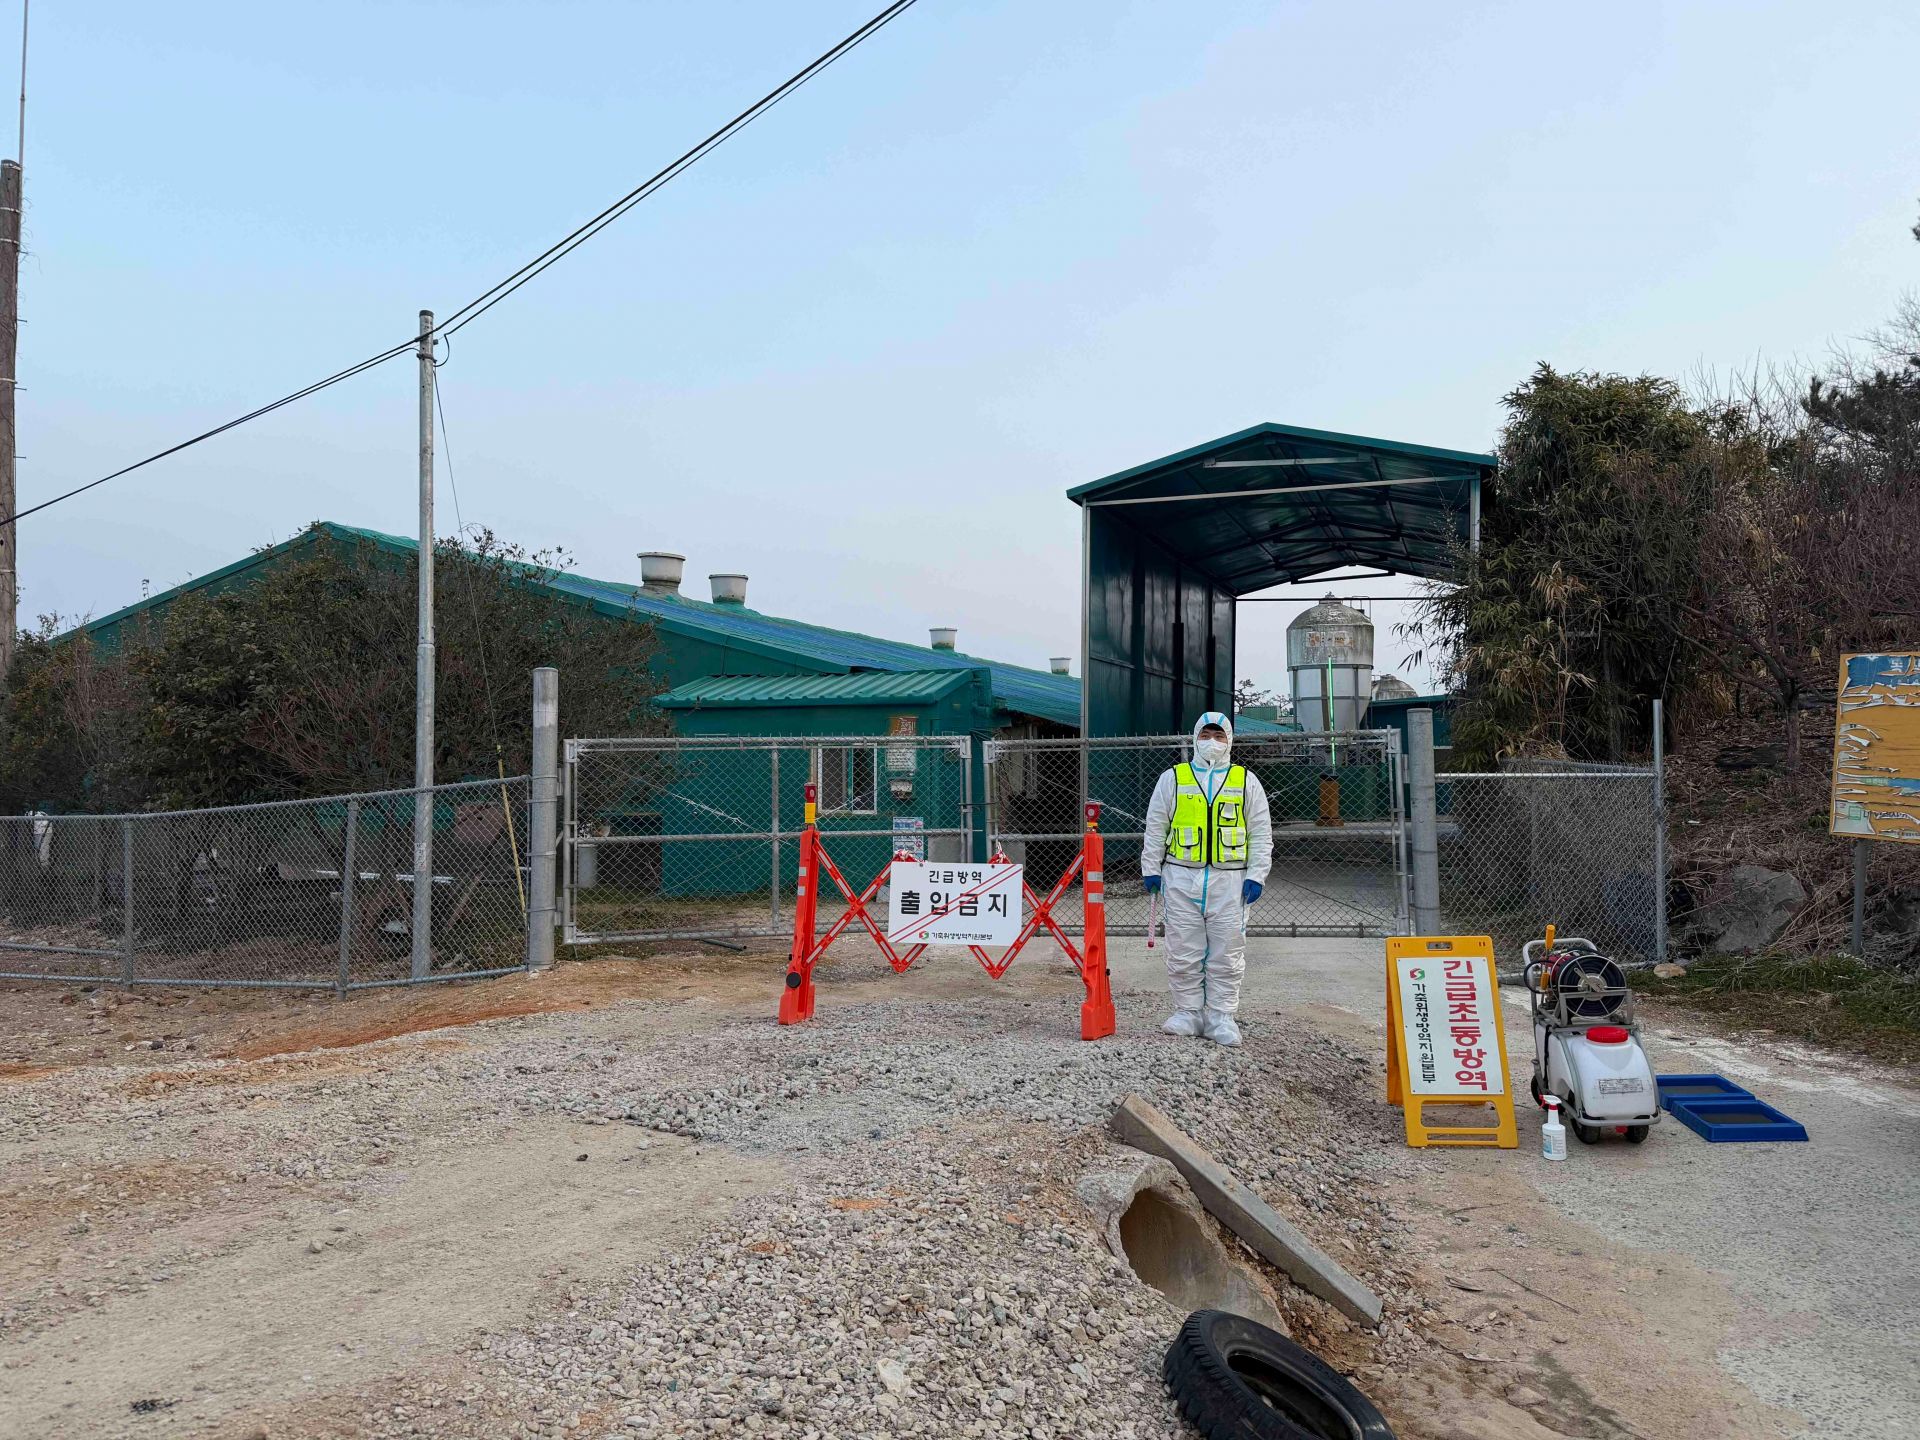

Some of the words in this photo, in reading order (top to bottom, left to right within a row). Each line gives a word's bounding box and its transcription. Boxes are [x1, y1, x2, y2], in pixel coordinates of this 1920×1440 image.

[900, 890, 1007, 918] 출입금지
[928, 870, 982, 885] 긴급방역
[1411, 983, 1436, 1084] 가축위생방역지원본부
[1443, 960, 1488, 1091] 긴급초동방역
